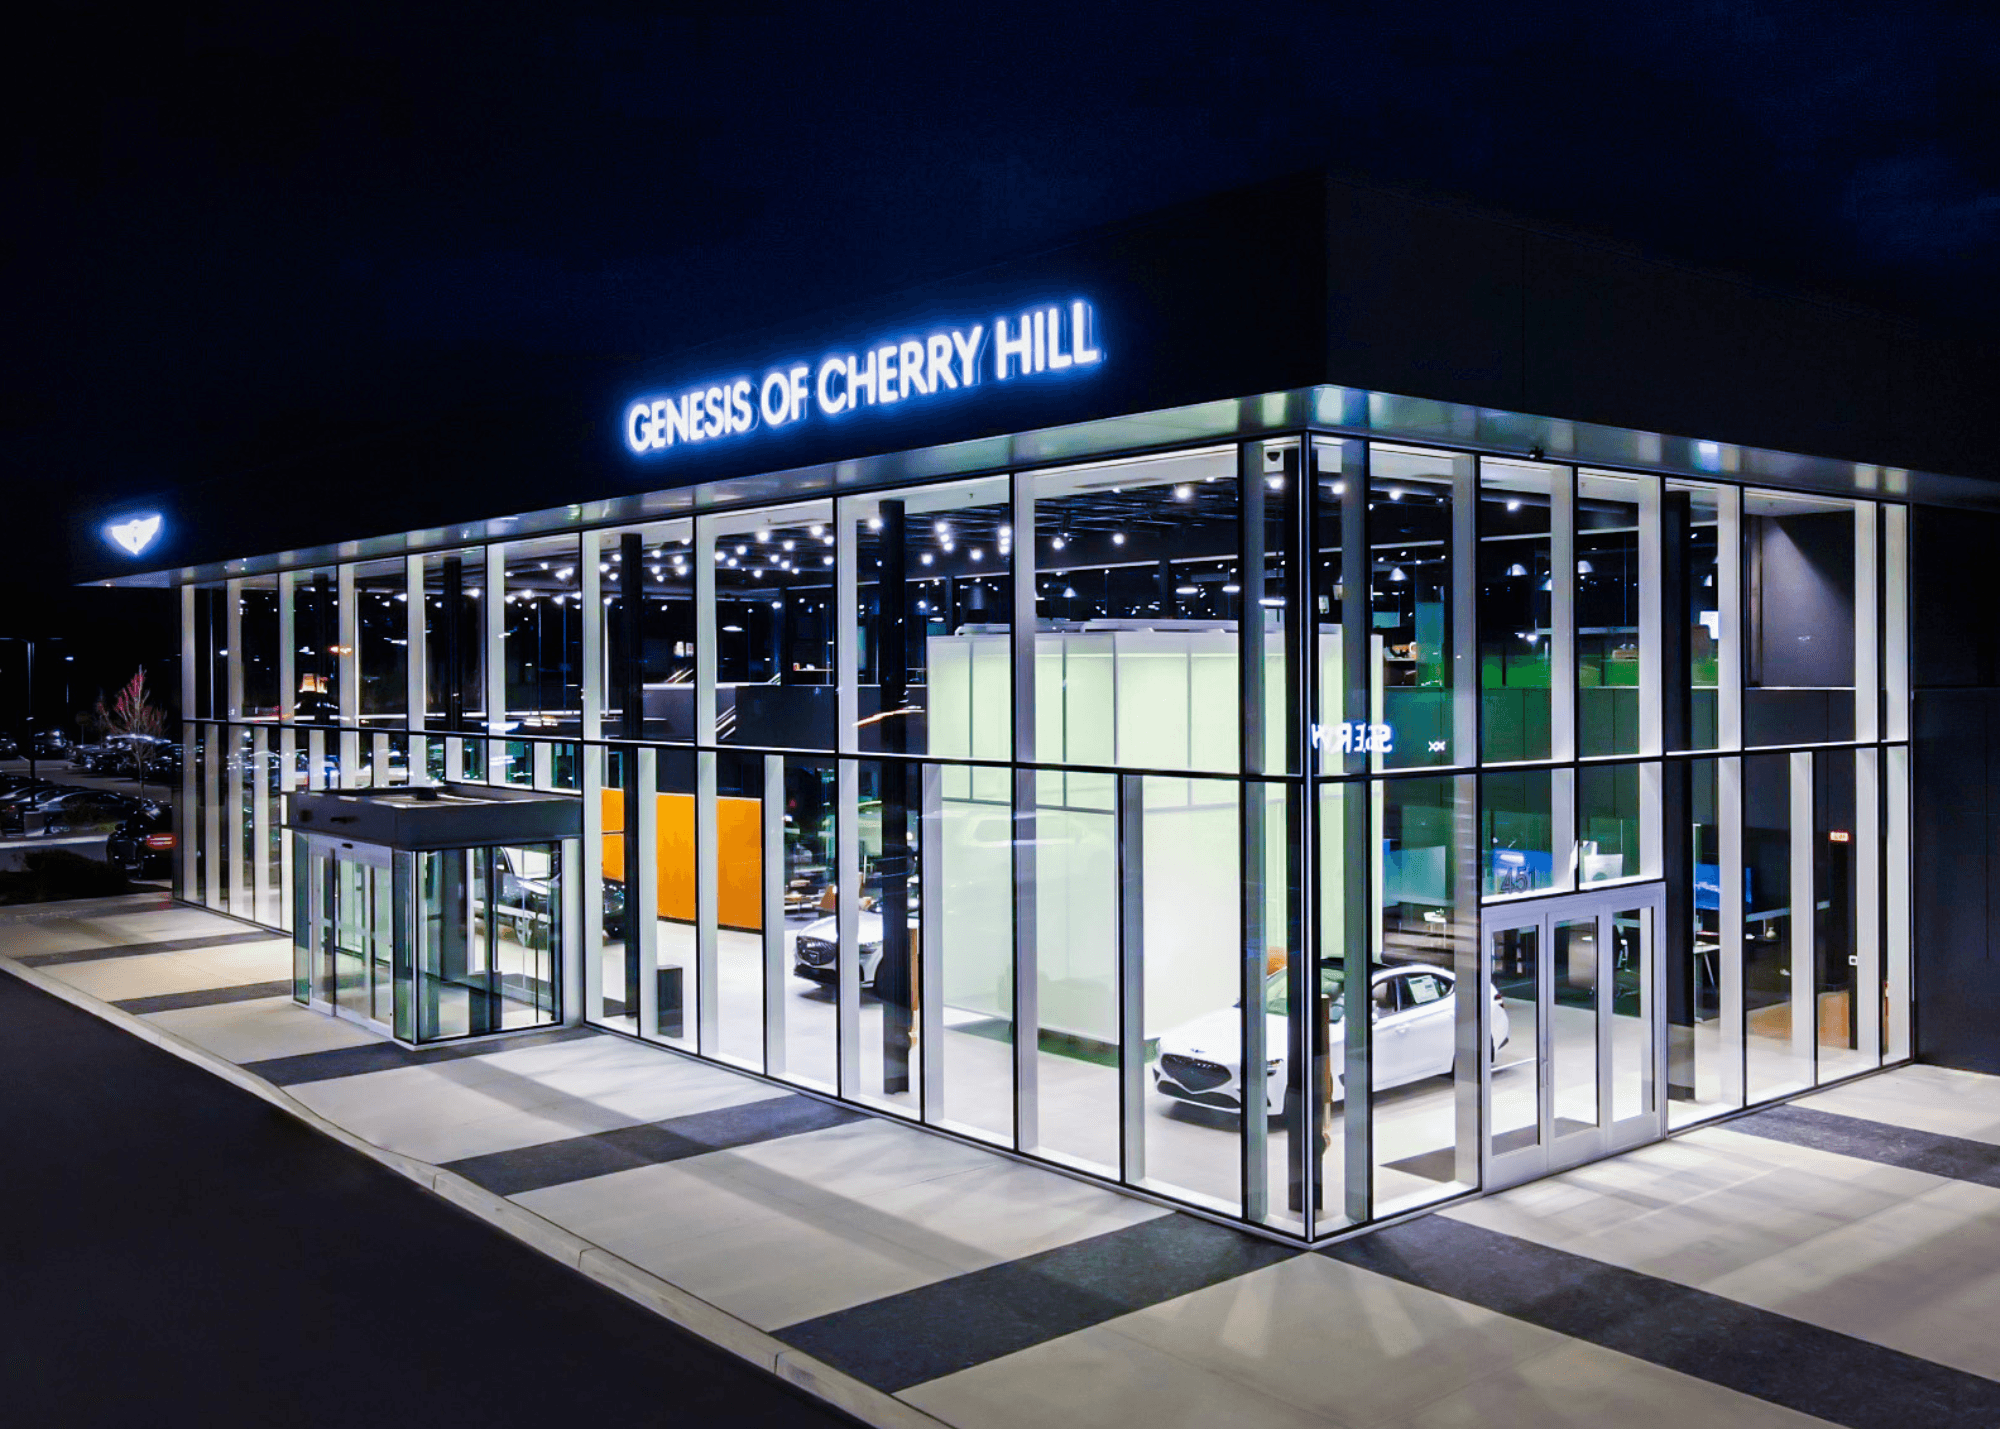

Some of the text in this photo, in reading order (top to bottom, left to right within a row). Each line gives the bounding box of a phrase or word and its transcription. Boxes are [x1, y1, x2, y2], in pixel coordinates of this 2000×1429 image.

[628, 302, 1098, 452] GENESIS OF CHERRY HILL
[1500, 866, 1536, 894] 451
